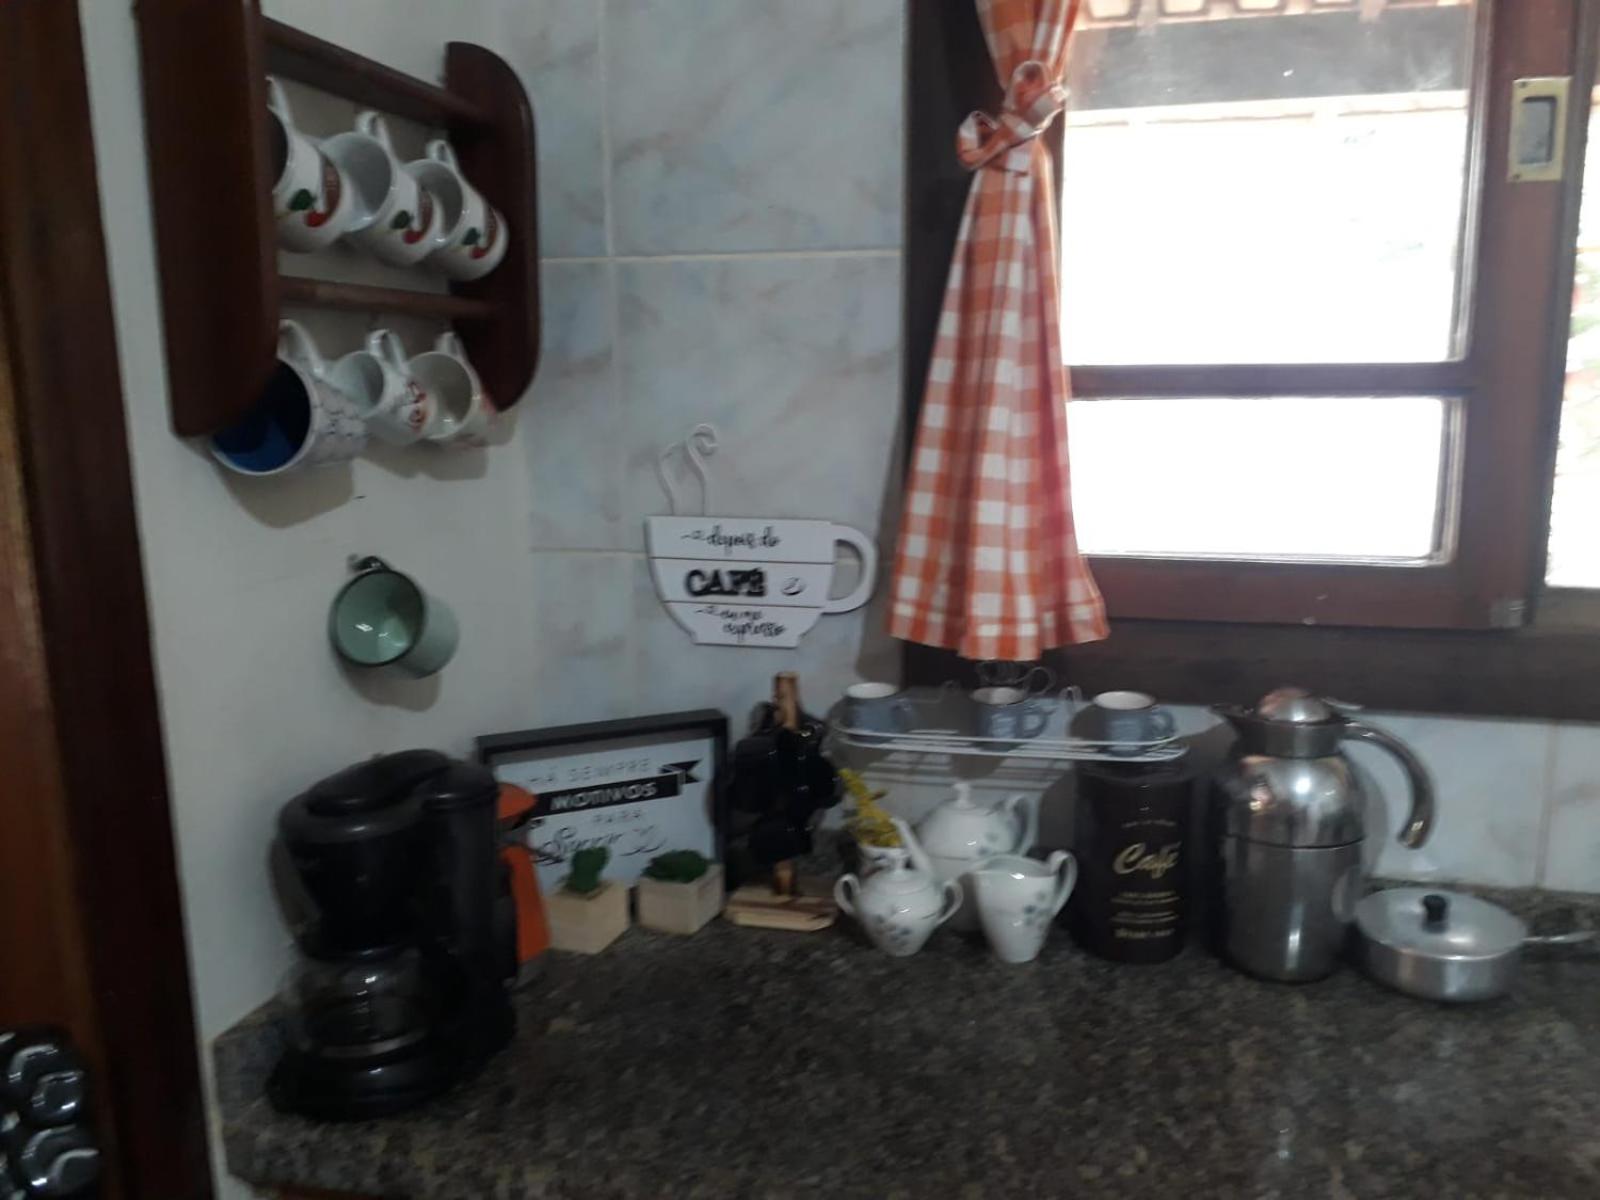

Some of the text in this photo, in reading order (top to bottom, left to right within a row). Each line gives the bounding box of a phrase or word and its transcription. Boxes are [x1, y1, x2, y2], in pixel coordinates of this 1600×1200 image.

[684, 567, 766, 597] CAFÉ
[549, 781, 658, 812] MOTIVOS
[1112, 841, 1182, 880] Café
